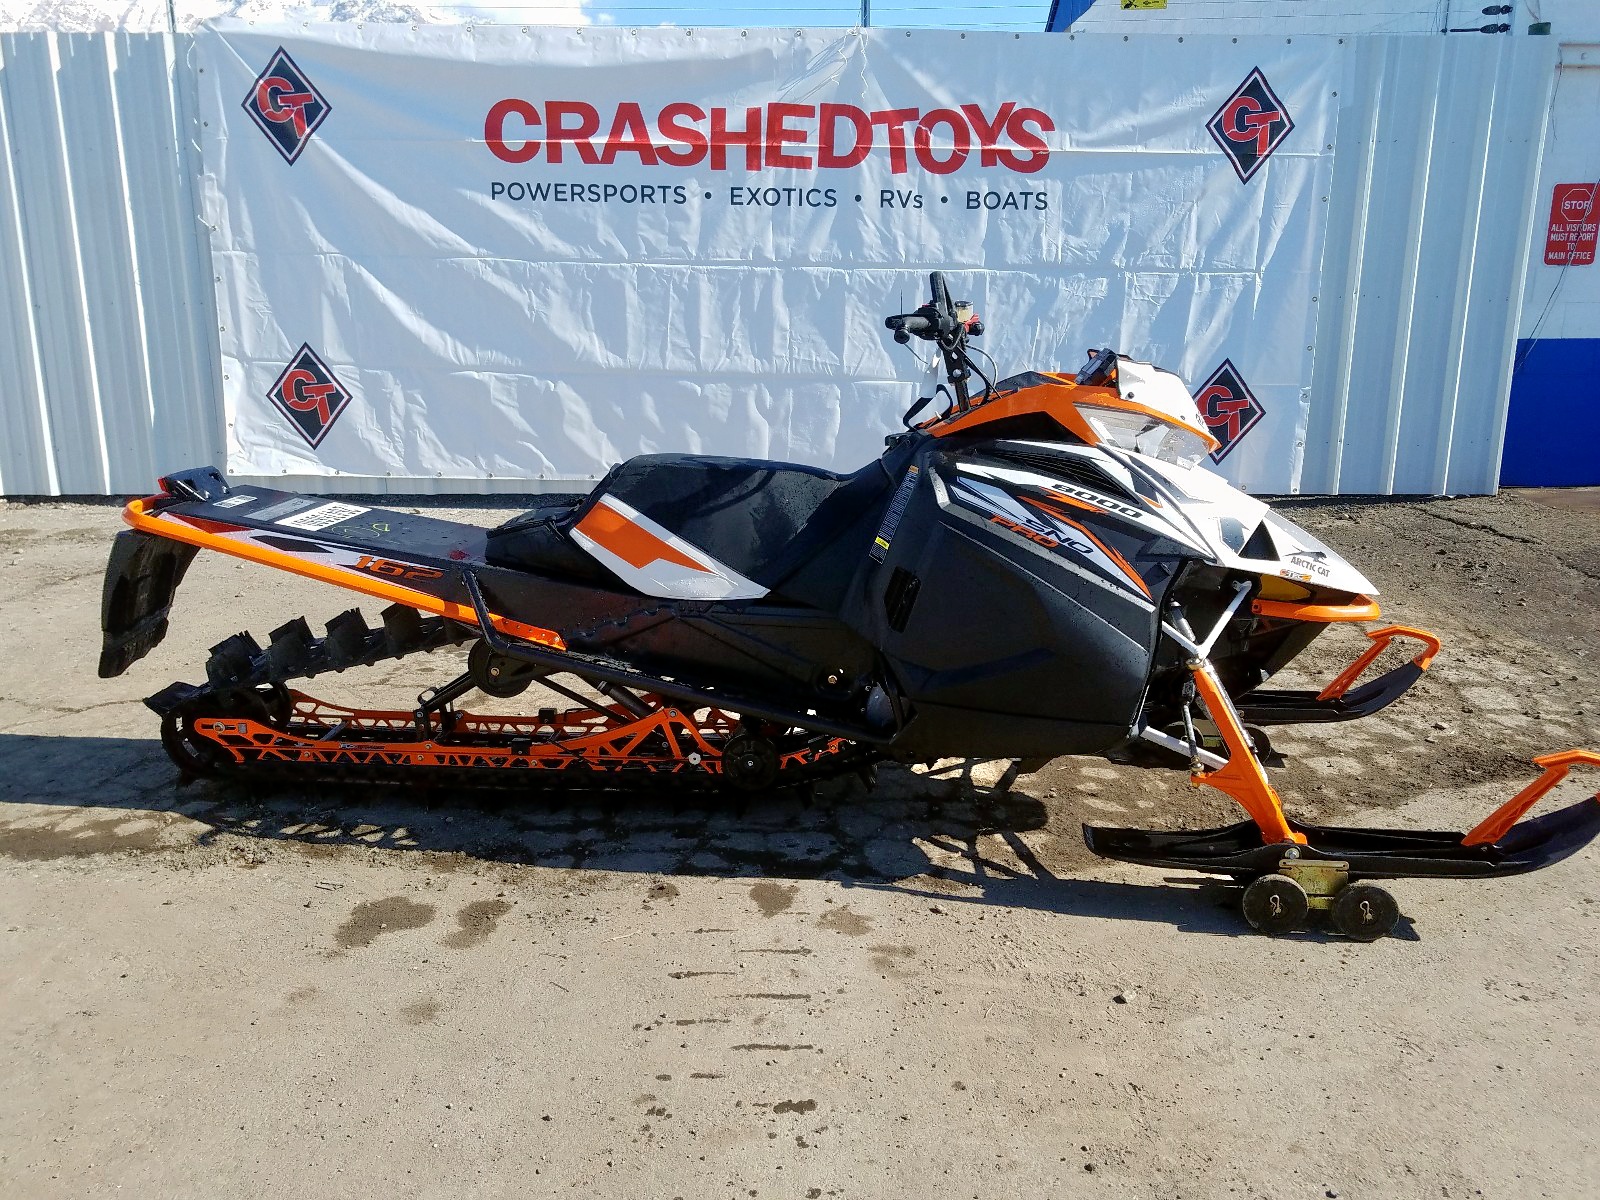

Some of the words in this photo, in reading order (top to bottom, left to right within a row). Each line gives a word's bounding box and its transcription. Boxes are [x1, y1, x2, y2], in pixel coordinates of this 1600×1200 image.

[484, 98, 1056, 175] CRASHEDTOYS
[491, 182, 687, 205] POWERSPORTS
[730, 186, 837, 208] EXOTICS
[880, 190, 923, 209] RVs
[966, 190, 1048, 210] BOATS
[1563, 200, 1591, 210] STOP
[1550, 232, 1568, 241] MUST
[1551, 223, 1564, 232] ALL
[1548, 251, 1566, 260] MAIN
[1566, 242, 1578, 251] TO
[991, 514, 1061, 549] PRO
[1020, 516, 1094, 554] SNO
[355, 555, 445, 583] 162
[1290, 556, 1316, 572] ARCTIC
[1317, 566, 1331, 578] CAT
